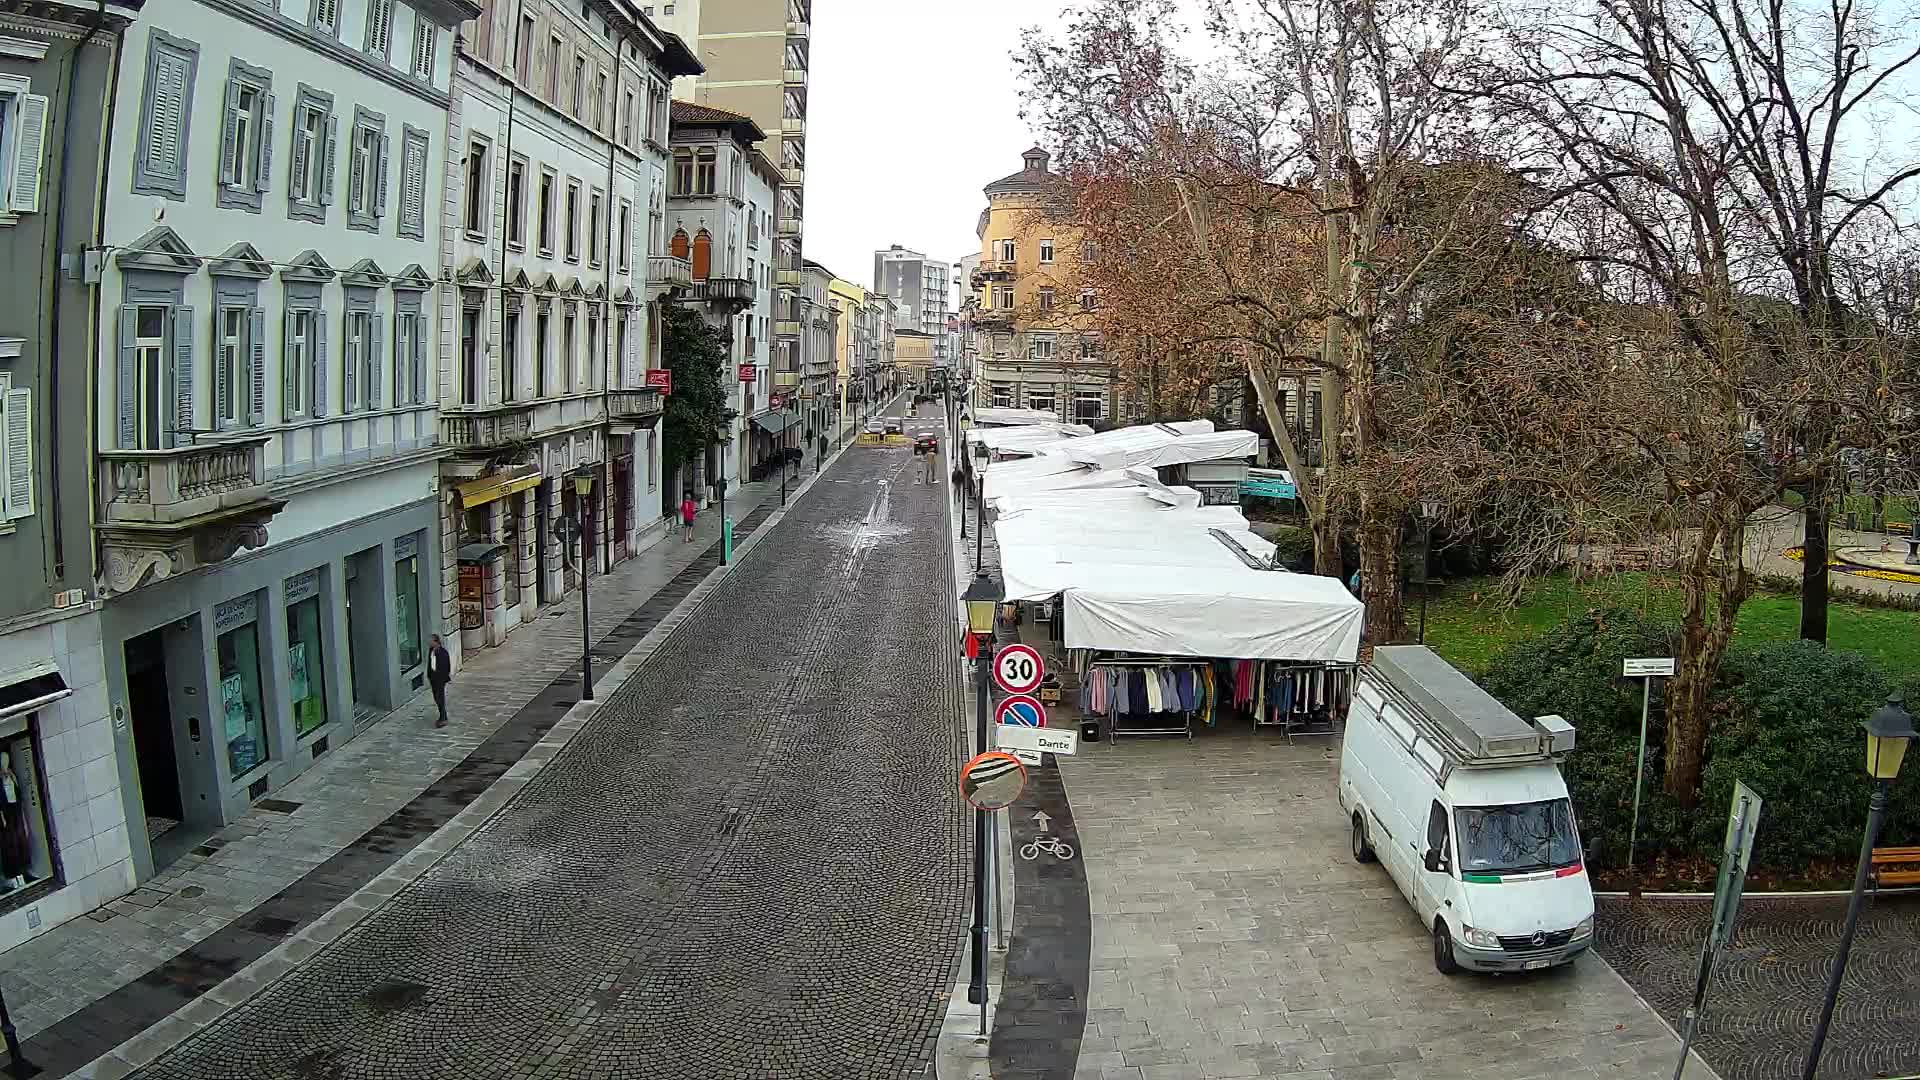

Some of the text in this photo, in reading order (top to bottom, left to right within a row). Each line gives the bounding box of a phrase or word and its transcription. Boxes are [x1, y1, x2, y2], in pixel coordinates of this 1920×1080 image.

[1005, 658, 1033, 680] 30
[223, 676, 241, 700] 130
[1038, 738, 1070, 750] Dante
